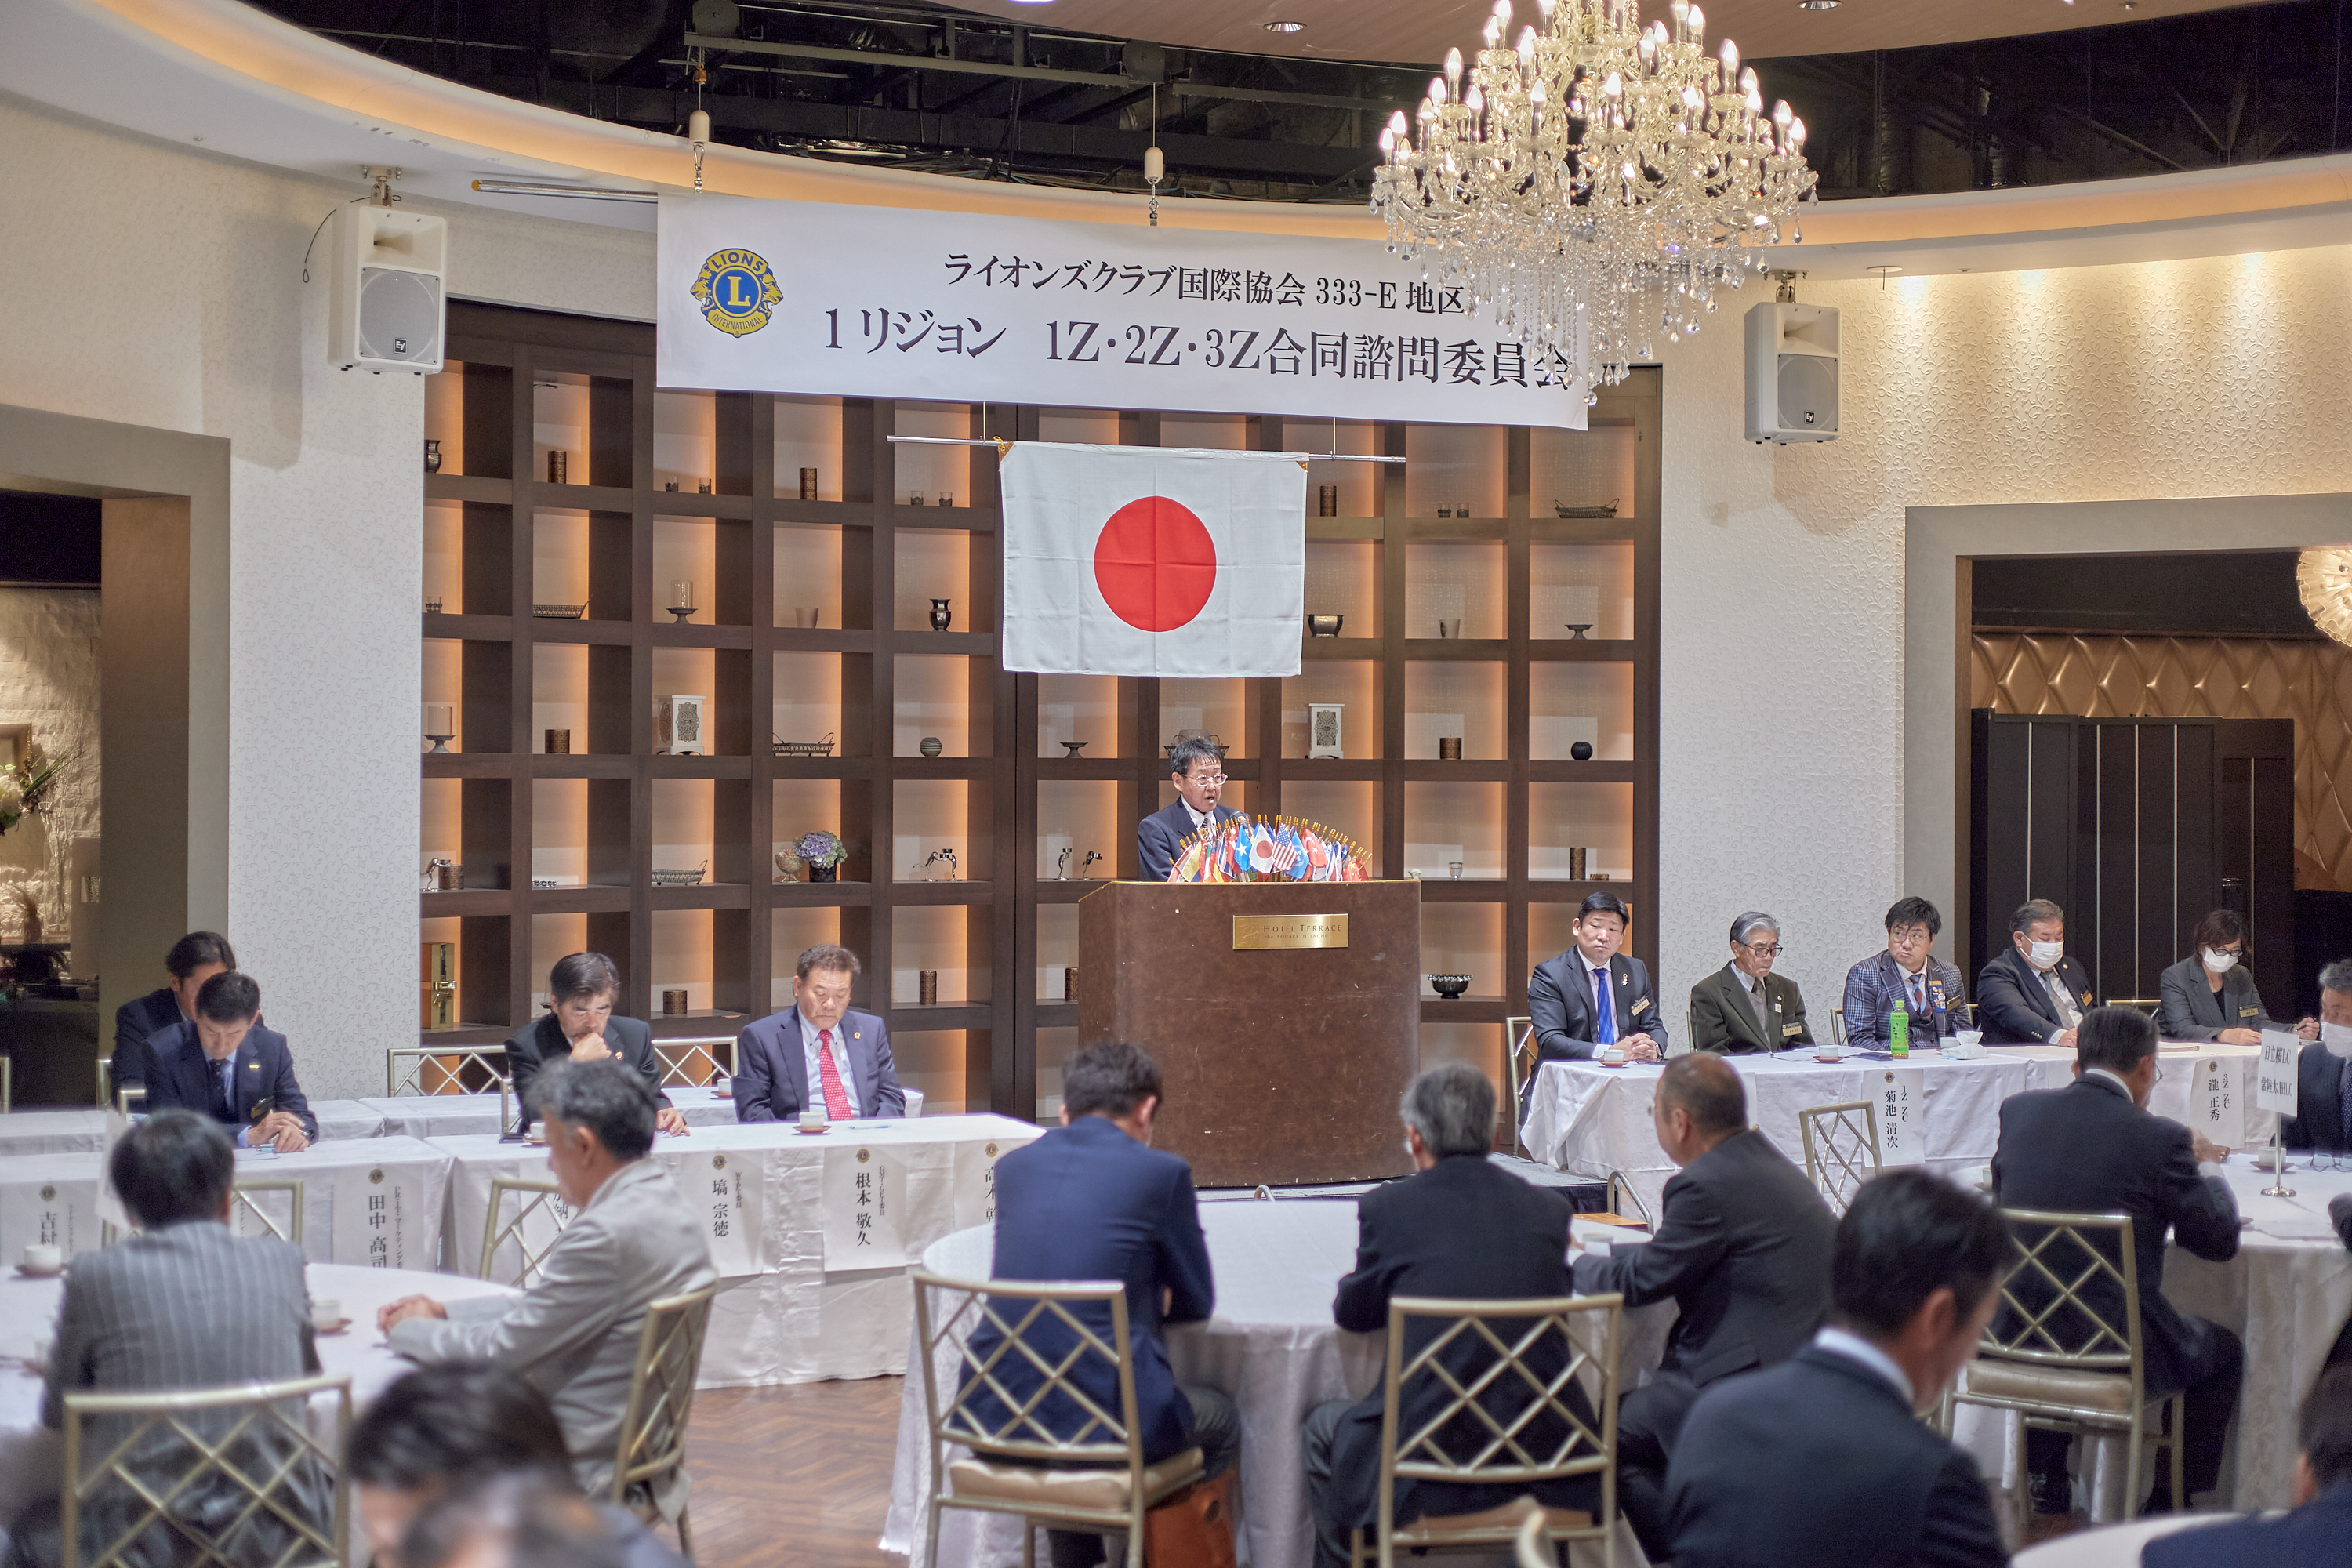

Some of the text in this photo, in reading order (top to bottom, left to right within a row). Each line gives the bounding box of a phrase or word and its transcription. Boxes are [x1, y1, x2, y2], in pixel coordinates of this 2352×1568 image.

[711, 252, 764, 272] LIONS
[728, 276, 750, 307] L
[945, 254, 1465, 314] ライオンズクラブ国際協会 333-E 地区
[711, 313, 764, 330] INTERNATIONAL
[1263, 924, 1341, 933] HOTEL TERRACE
[1885, 1090, 1899, 1149] 菊池 清次
[2209, 1096, 2220, 1122] 正秀
[713, 1203, 729, 1237] 宗徳
[855, 1172, 872, 1247] 根本 敬久
[369, 1195, 387, 1268] 田中 高司
